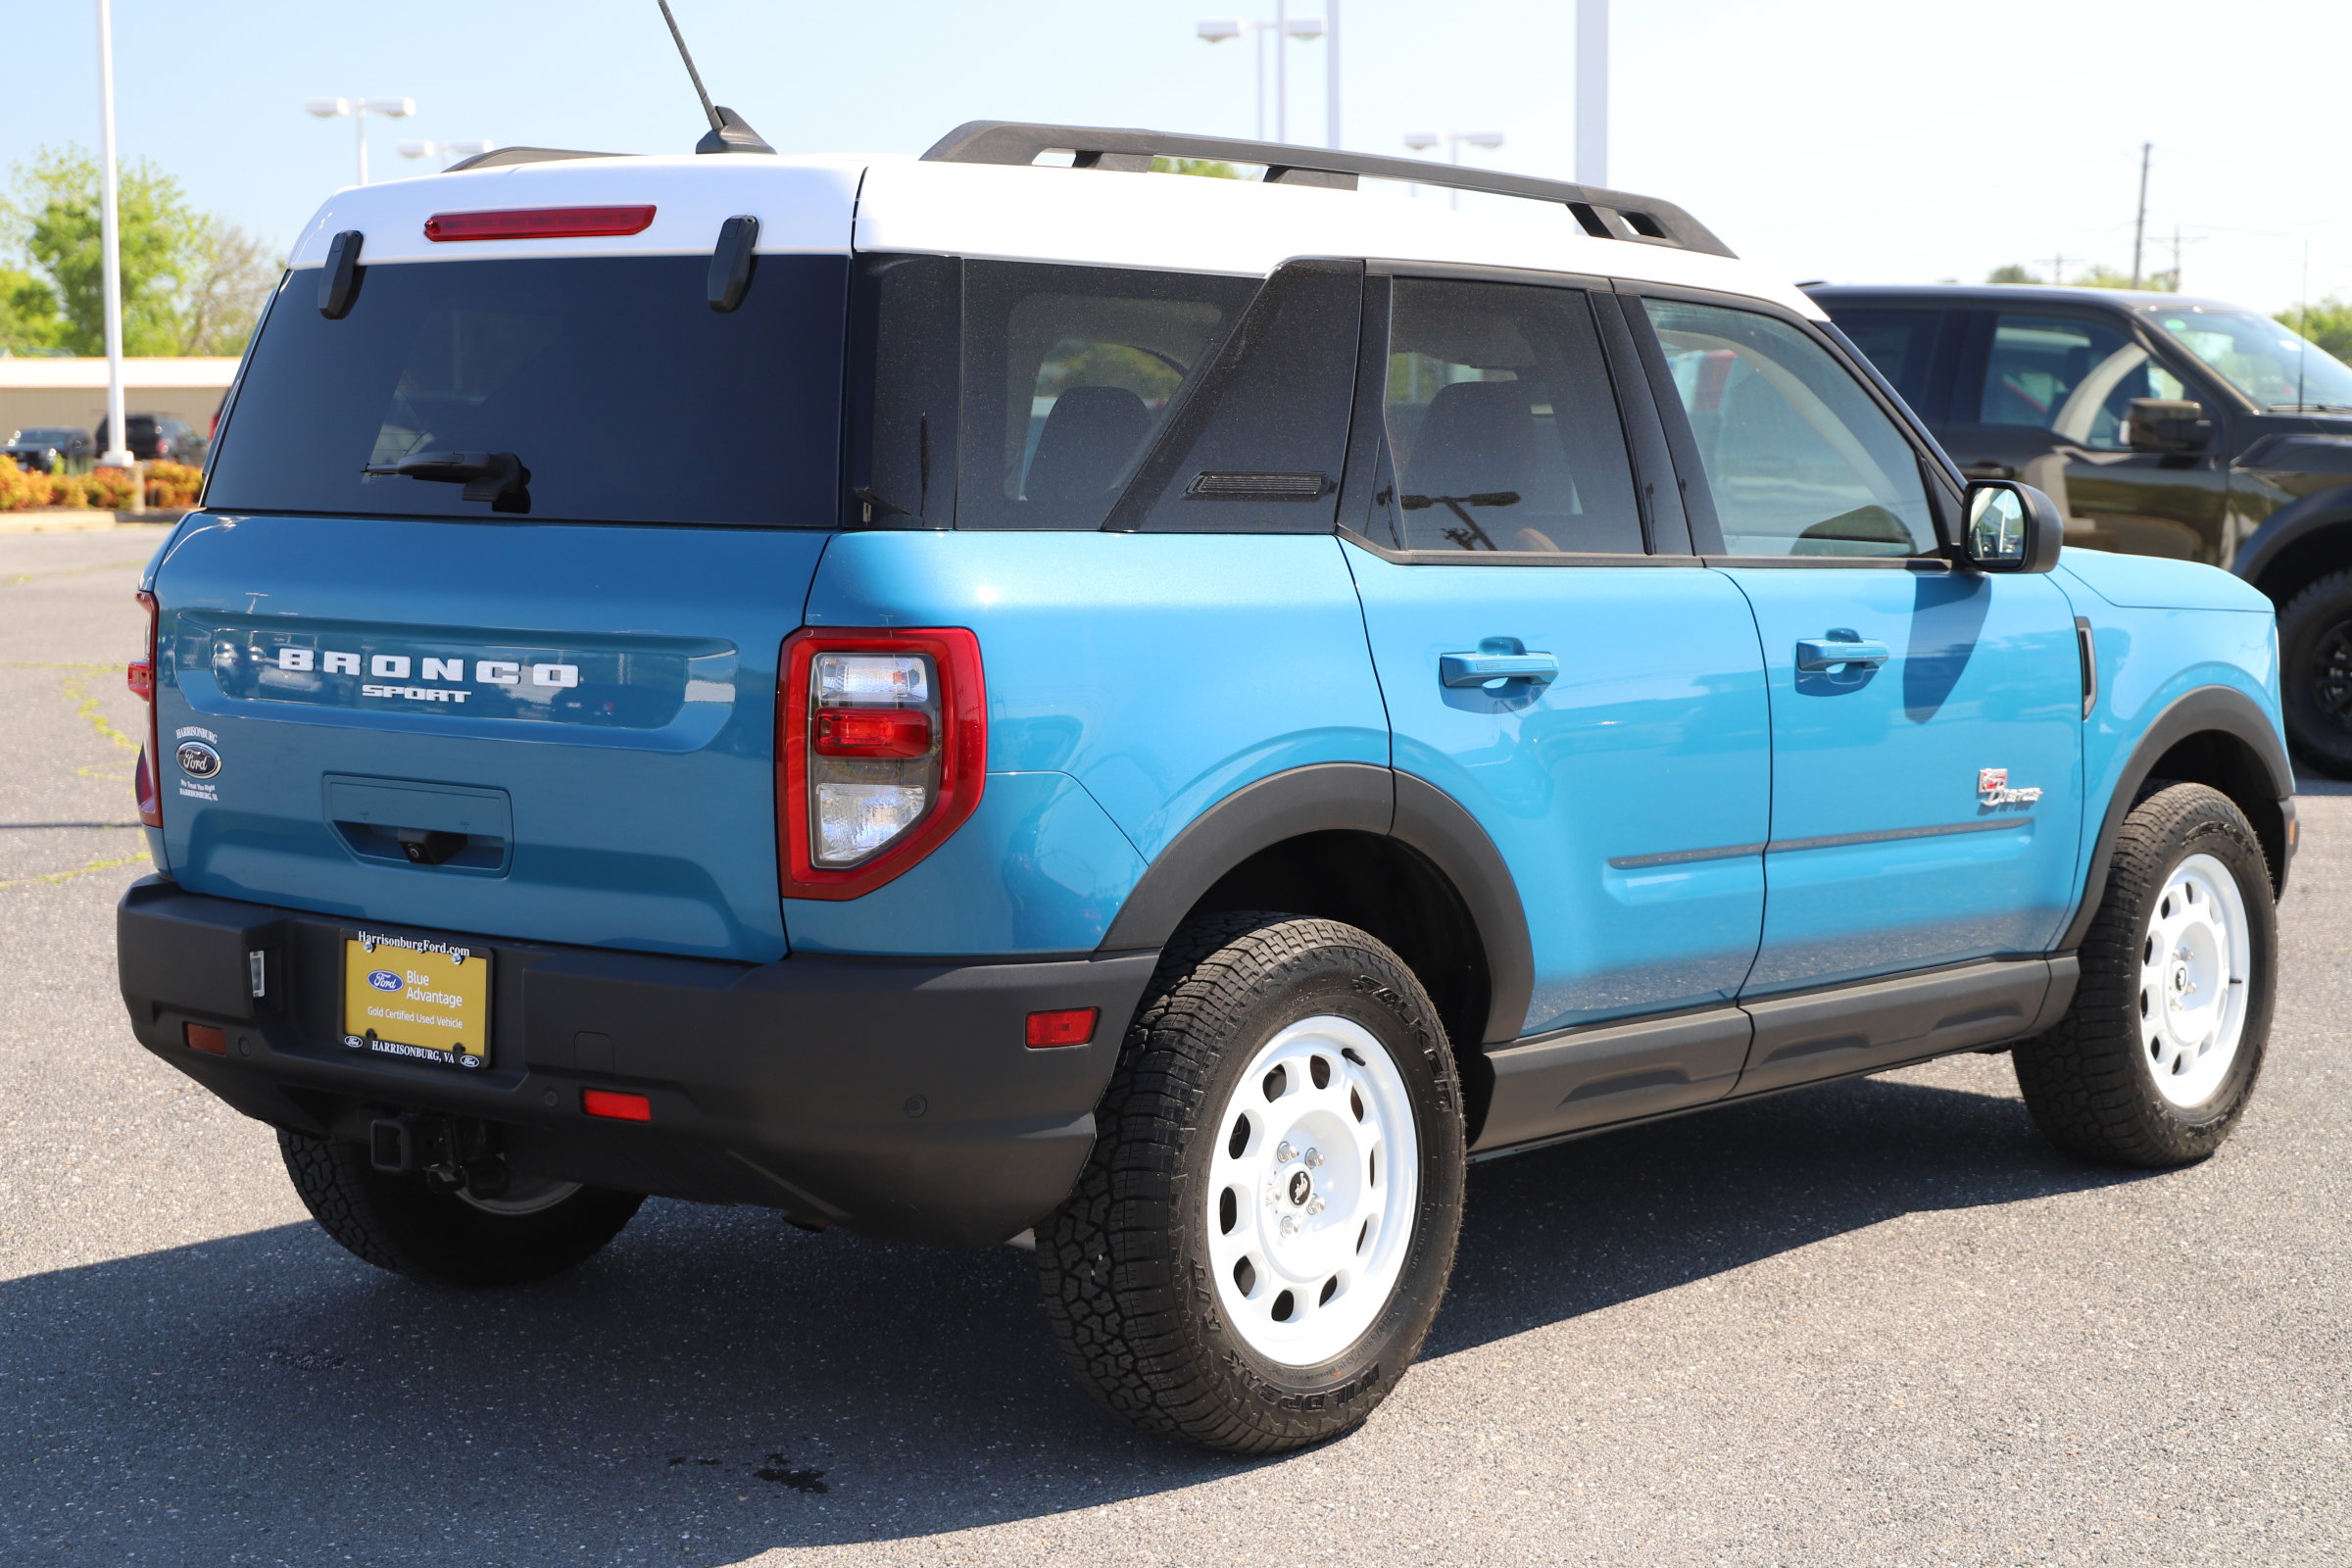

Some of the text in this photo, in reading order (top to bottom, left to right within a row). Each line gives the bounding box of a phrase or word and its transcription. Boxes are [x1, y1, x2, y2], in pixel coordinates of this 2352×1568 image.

[279, 647, 579, 688] BRONCO
[362, 684, 471, 704] SPORT
[175, 726, 218, 744] HARRISONBURG
[183, 749, 208, 771] Ford
[358, 931, 470, 957] HarrisonburgFord.com
[373, 970, 429, 990] Ford Blue
[407, 987, 463, 1008] Advantage
[368, 1005, 463, 1029] Gold Certified Used Vehicle
[372, 1041, 455, 1063] HARRISONBURG, VA
